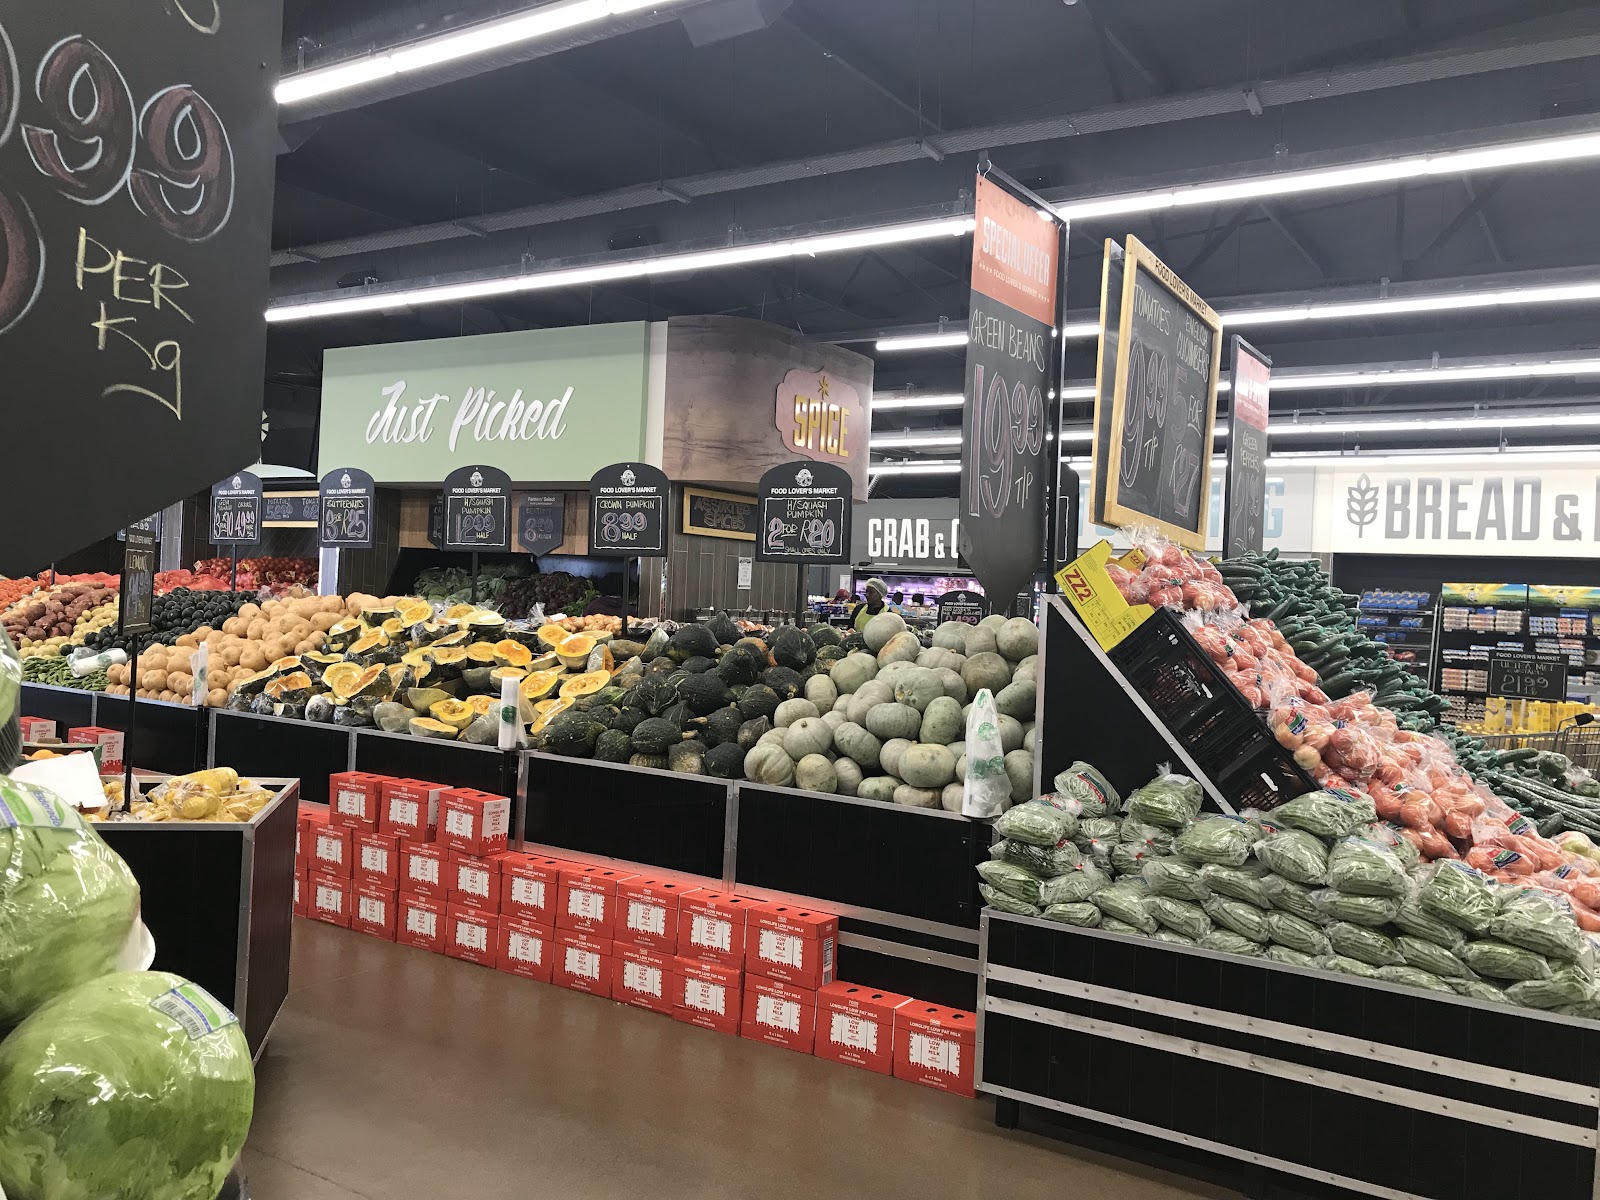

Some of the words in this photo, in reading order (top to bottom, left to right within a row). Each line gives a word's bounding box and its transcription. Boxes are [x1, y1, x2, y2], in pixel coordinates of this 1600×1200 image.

[983, 216, 1022, 273] SPECIAL
[1023, 241, 1050, 287] OFFER
[75, 226, 194, 323] PER
[993, 268, 1005, 282] FOOD
[1022, 283, 1038, 298] MARKET
[1154, 260, 1168, 282] FOOD
[1190, 291, 1208, 316] MARKET
[1134, 284, 1171, 336] TOMATOES
[970, 308, 1006, 352] GREEN
[1008, 324, 1046, 373] BEANS
[1185, 312, 1208, 348] ENGLISH
[366, 380, 450, 444] Just
[448, 386, 576, 453] Picked
[794, 394, 850, 458] SPICE
[1188, 394, 1203, 430] FOR
[600, 500, 622, 509] CROWN
[626, 500, 654, 509] PUMPKIN
[704, 512, 746, 530] SPICES
[786, 510, 824, 518] PUMPKIN
[787, 500, 828, 510] H/SQUASH
[1384, 476, 1542, 541] BREAD
[1552, 494, 1582, 541] &
[326, 509, 338, 540] 3
[622, 532, 638, 540] HALF
[768, 517, 784, 549] 2
[782, 524, 798, 535] FOR
[800, 518, 835, 548] R20
[868, 518, 930, 558] GRAB
[934, 533, 946, 559] &
[1065, 568, 1092, 602] ZZ2
[910, 1022, 929, 1030] LONGLIFE
